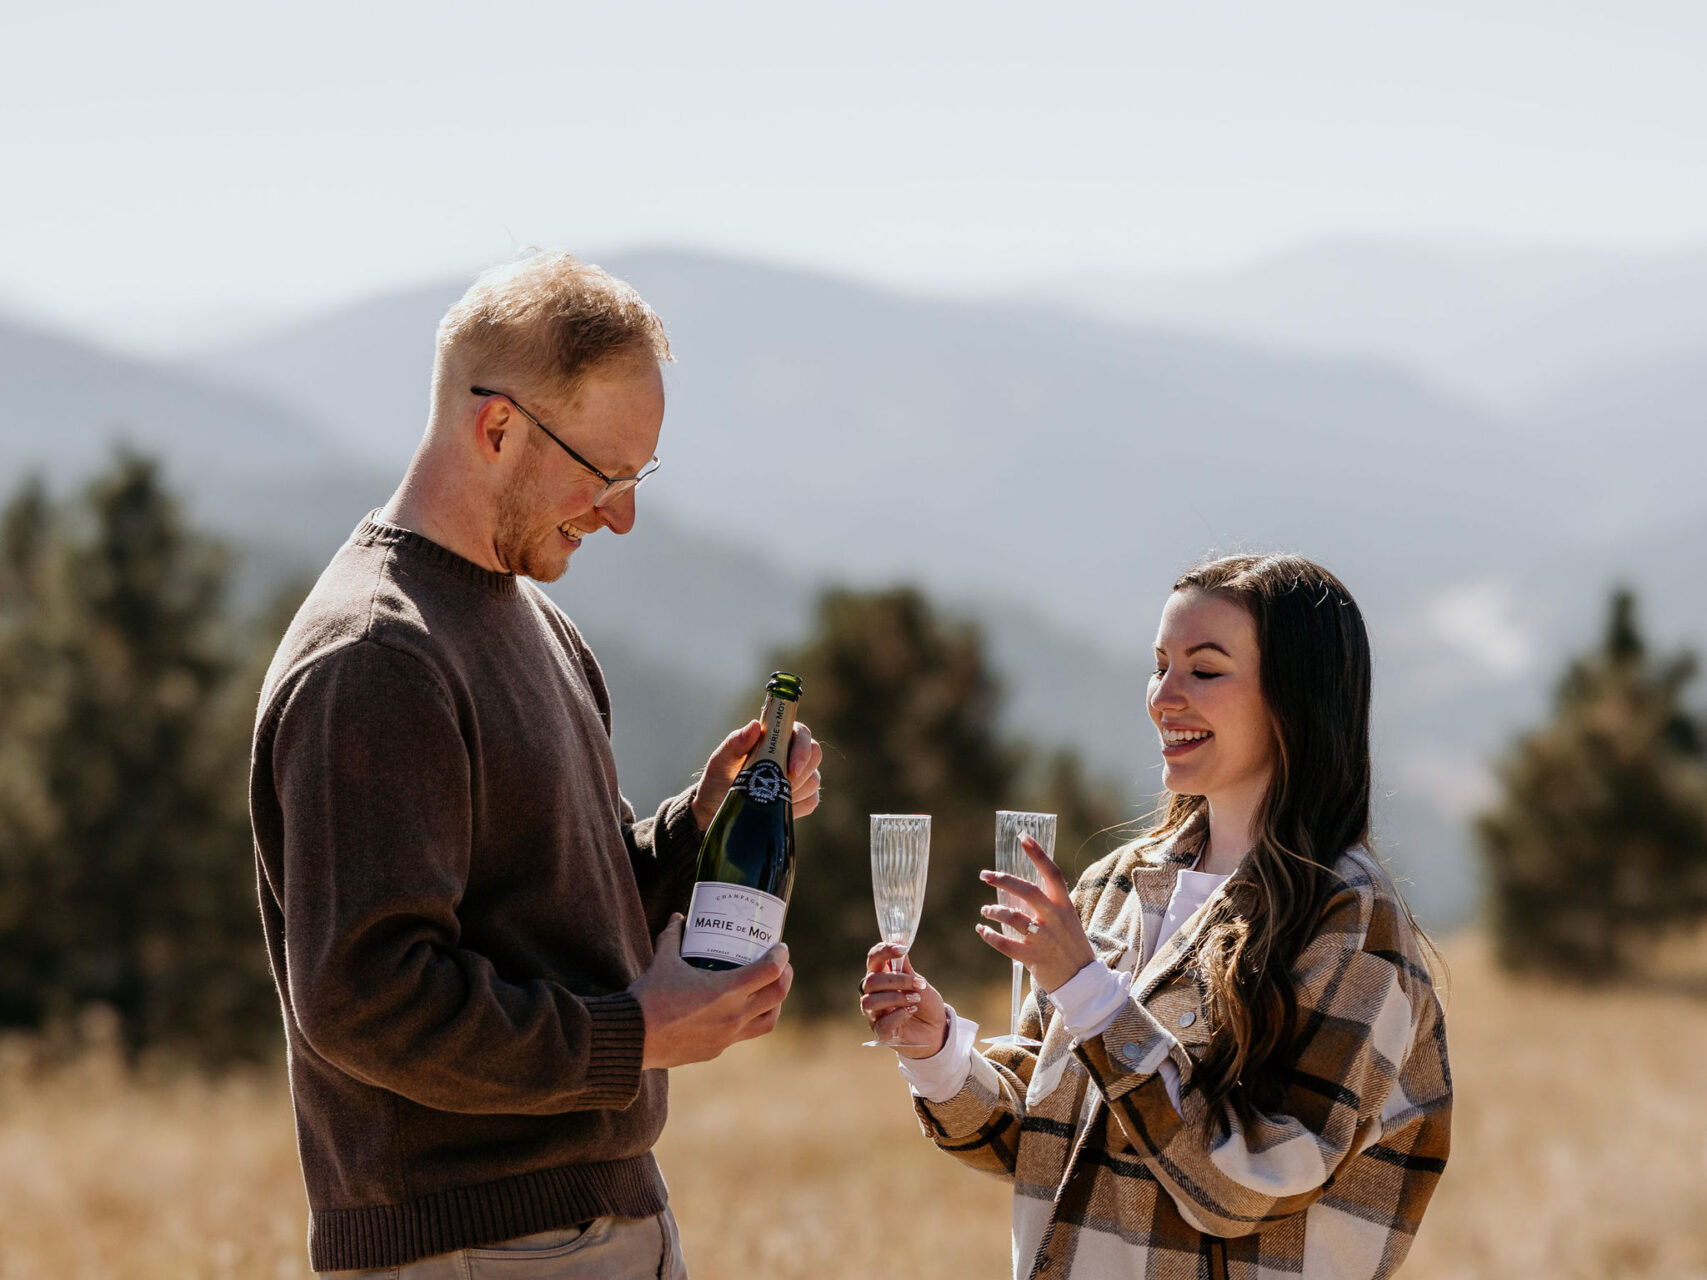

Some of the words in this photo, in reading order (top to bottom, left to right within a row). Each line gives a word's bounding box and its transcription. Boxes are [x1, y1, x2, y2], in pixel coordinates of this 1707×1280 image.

[768, 728, 780, 754] MARIE
[775, 702, 786, 719] MOY
[717, 893, 763, 910] CHAMPAGNE
[695, 917, 734, 930] MARIE
[736, 925, 746, 933] DE
[748, 926, 772, 942] MOY
